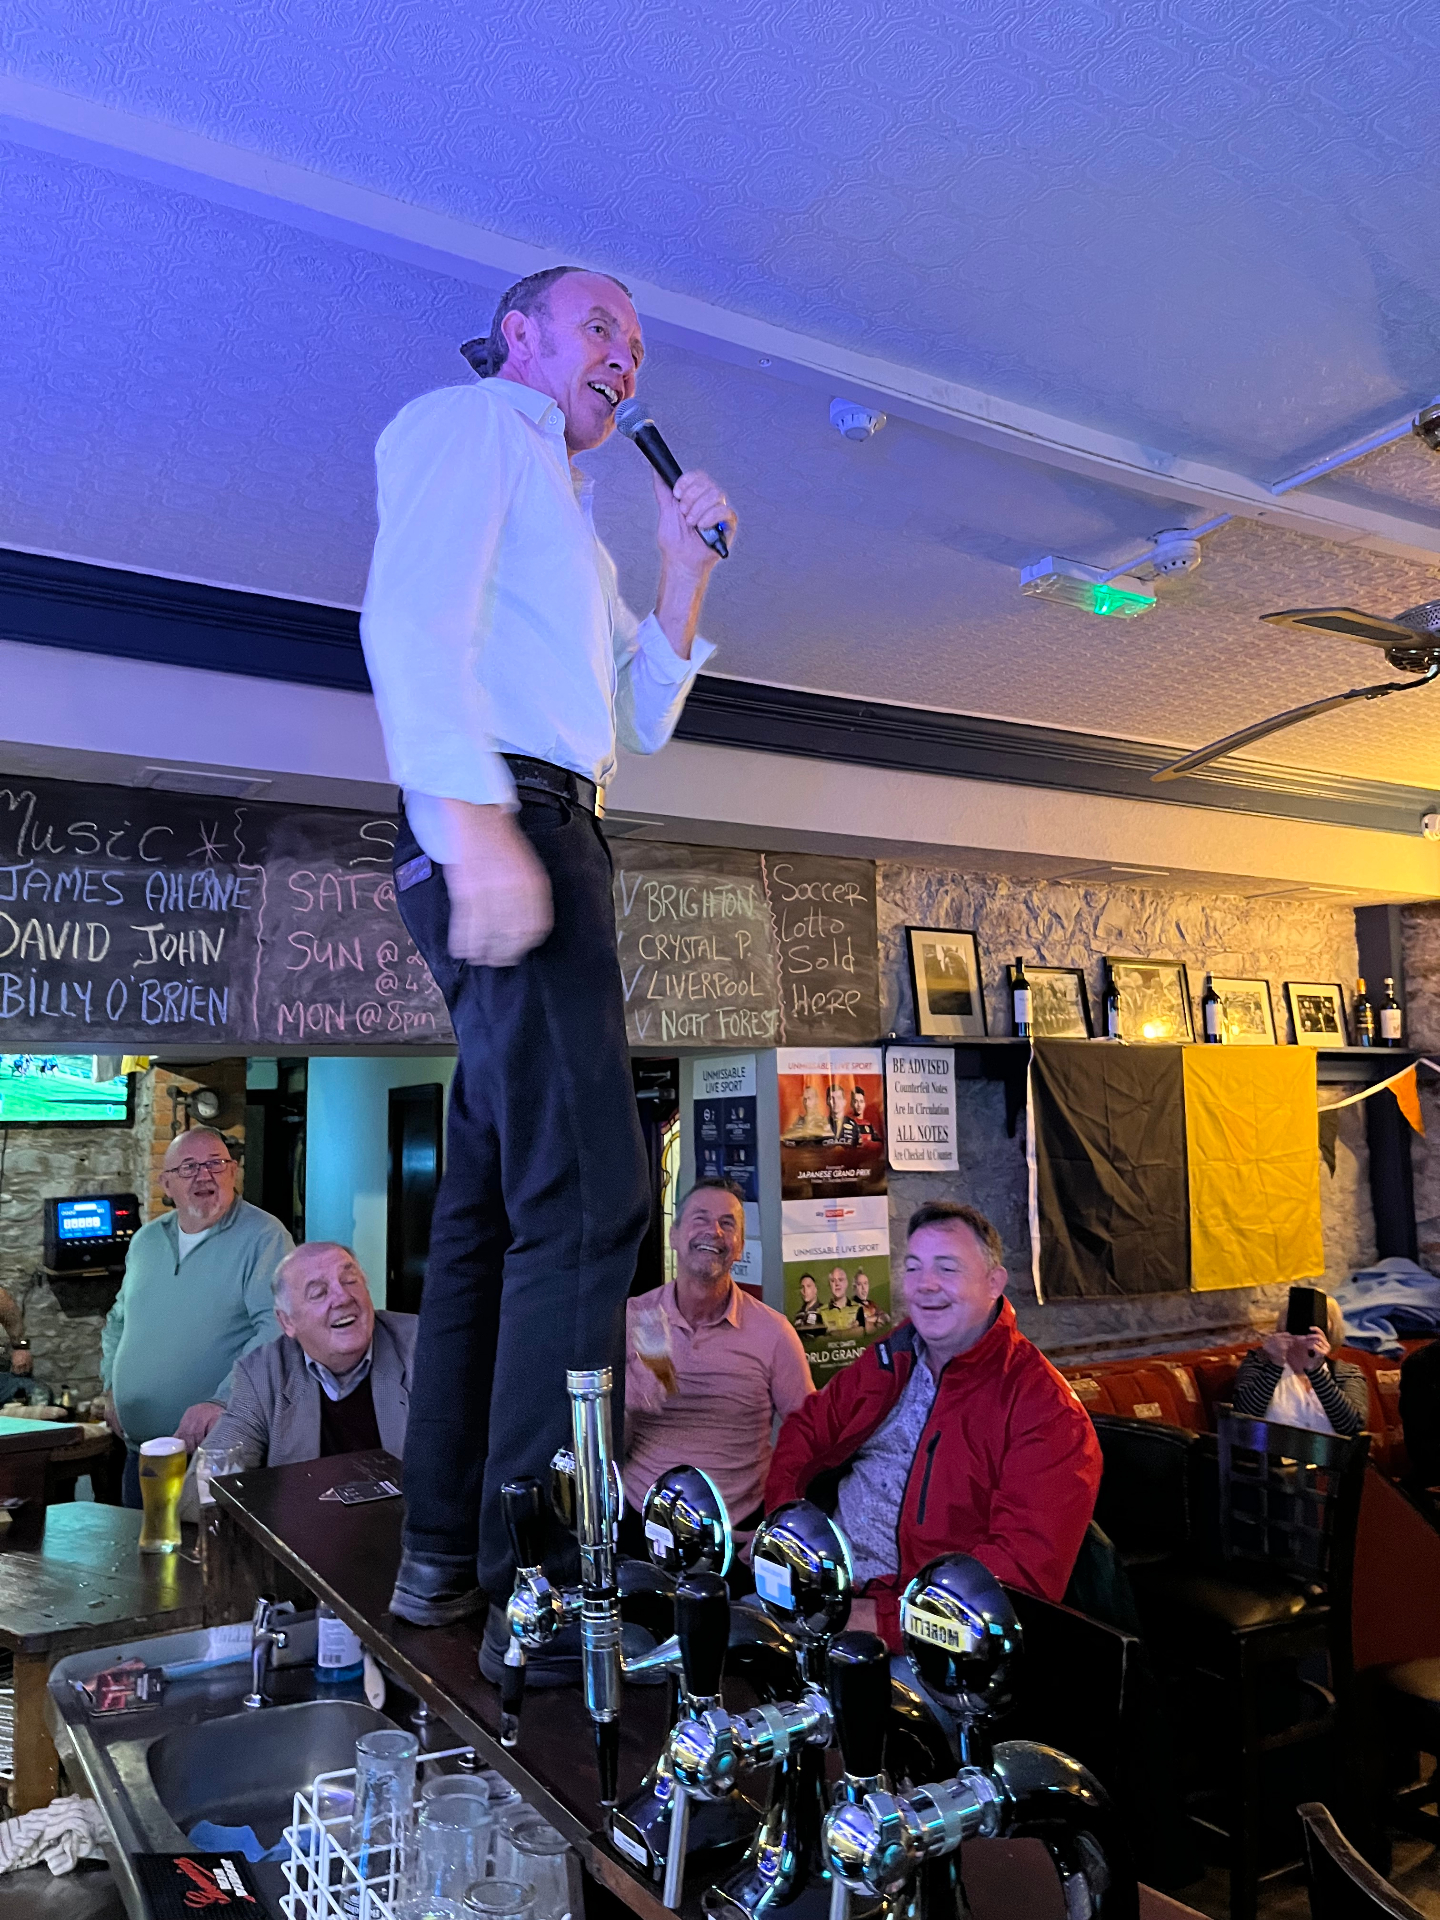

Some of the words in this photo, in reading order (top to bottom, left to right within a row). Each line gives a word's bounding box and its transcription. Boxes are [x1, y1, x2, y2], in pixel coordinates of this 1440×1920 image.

[0, 859, 124, 905] JAMES
[288, 870, 392, 913] SAT
[643, 881, 758, 923] BRIGHTON
[0, 911, 110, 962] DAVID
[286, 930, 364, 971] SUN
[638, 934, 732, 964] CRYSTAL
[646, 970, 764, 1001] LIVERPOOL
[277, 1000, 345, 1038] MON
[715, 1006, 780, 1040] FOREST
[702, 1066, 747, 1082] UNMISSABLE
[892, 1057, 906, 1074] BE
[907, 1058, 949, 1075] ADVISED
[705, 1081, 720, 1094] LIVE
[720, 1080, 743, 1093] SPORT
[931, 1081, 948, 1095] Notes
[893, 1102, 906, 1115] Are
[896, 1124, 916, 1141] ALL
[917, 1124, 949, 1142] NOTES
[797, 1170, 832, 1179] JAPANESE
[832, 1169, 855, 1178] GRAND
[856, 1168, 872, 1176] PRIX
[793, 1246, 840, 1257] UNMISSABLE
[841, 1245, 857, 1254] LIVE
[858, 1243, 880, 1253] SPORT
